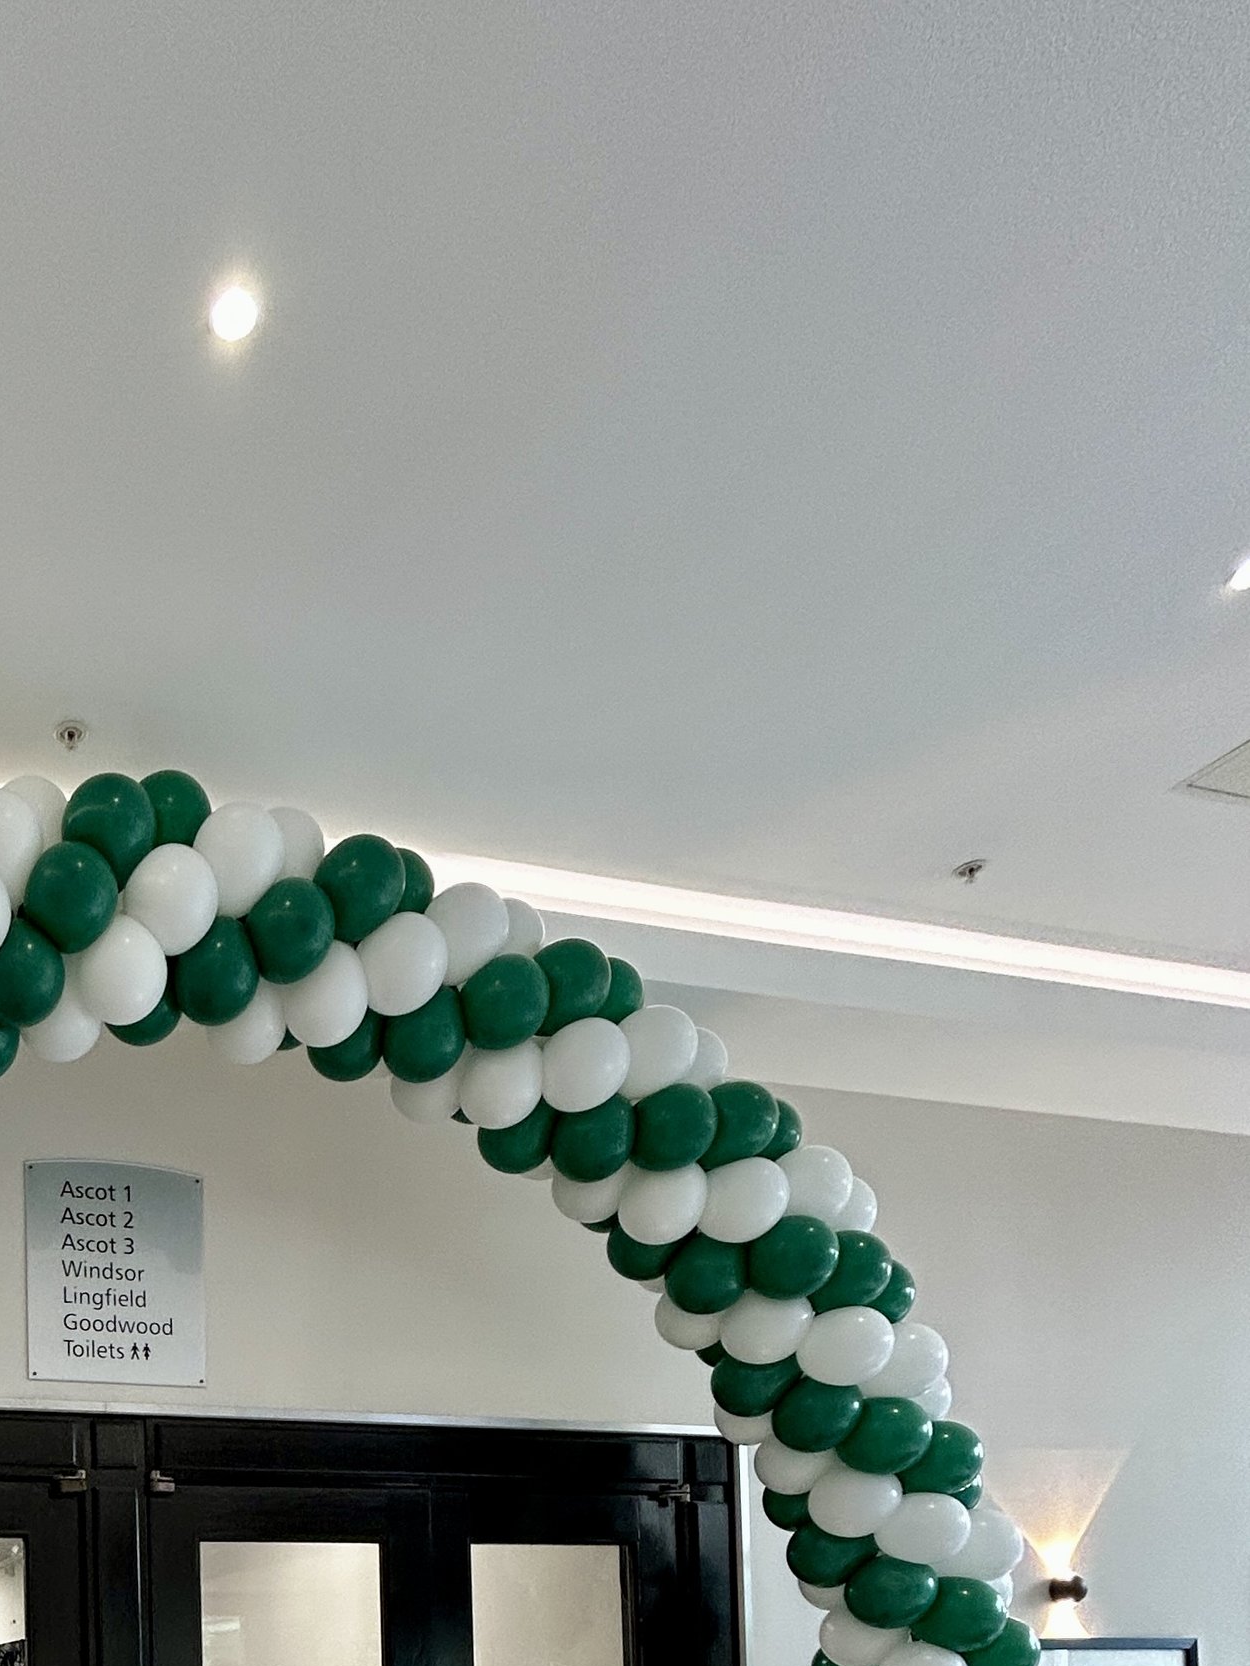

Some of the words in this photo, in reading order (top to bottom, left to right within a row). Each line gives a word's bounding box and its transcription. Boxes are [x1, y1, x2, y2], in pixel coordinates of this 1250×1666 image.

[60, 1181, 116, 1202] Ascot
[123, 1185, 131, 1202] 1
[60, 1207, 117, 1228] Ascot
[123, 1211, 134, 1229] 2
[61, 1233, 117, 1254] Ascot
[123, 1237, 135, 1255] 3
[62, 1259, 145, 1282] Windsor
[63, 1286, 147, 1310] Lingfield
[63, 1313, 174, 1336] Goodwood
[63, 1339, 125, 1360] Toilets
